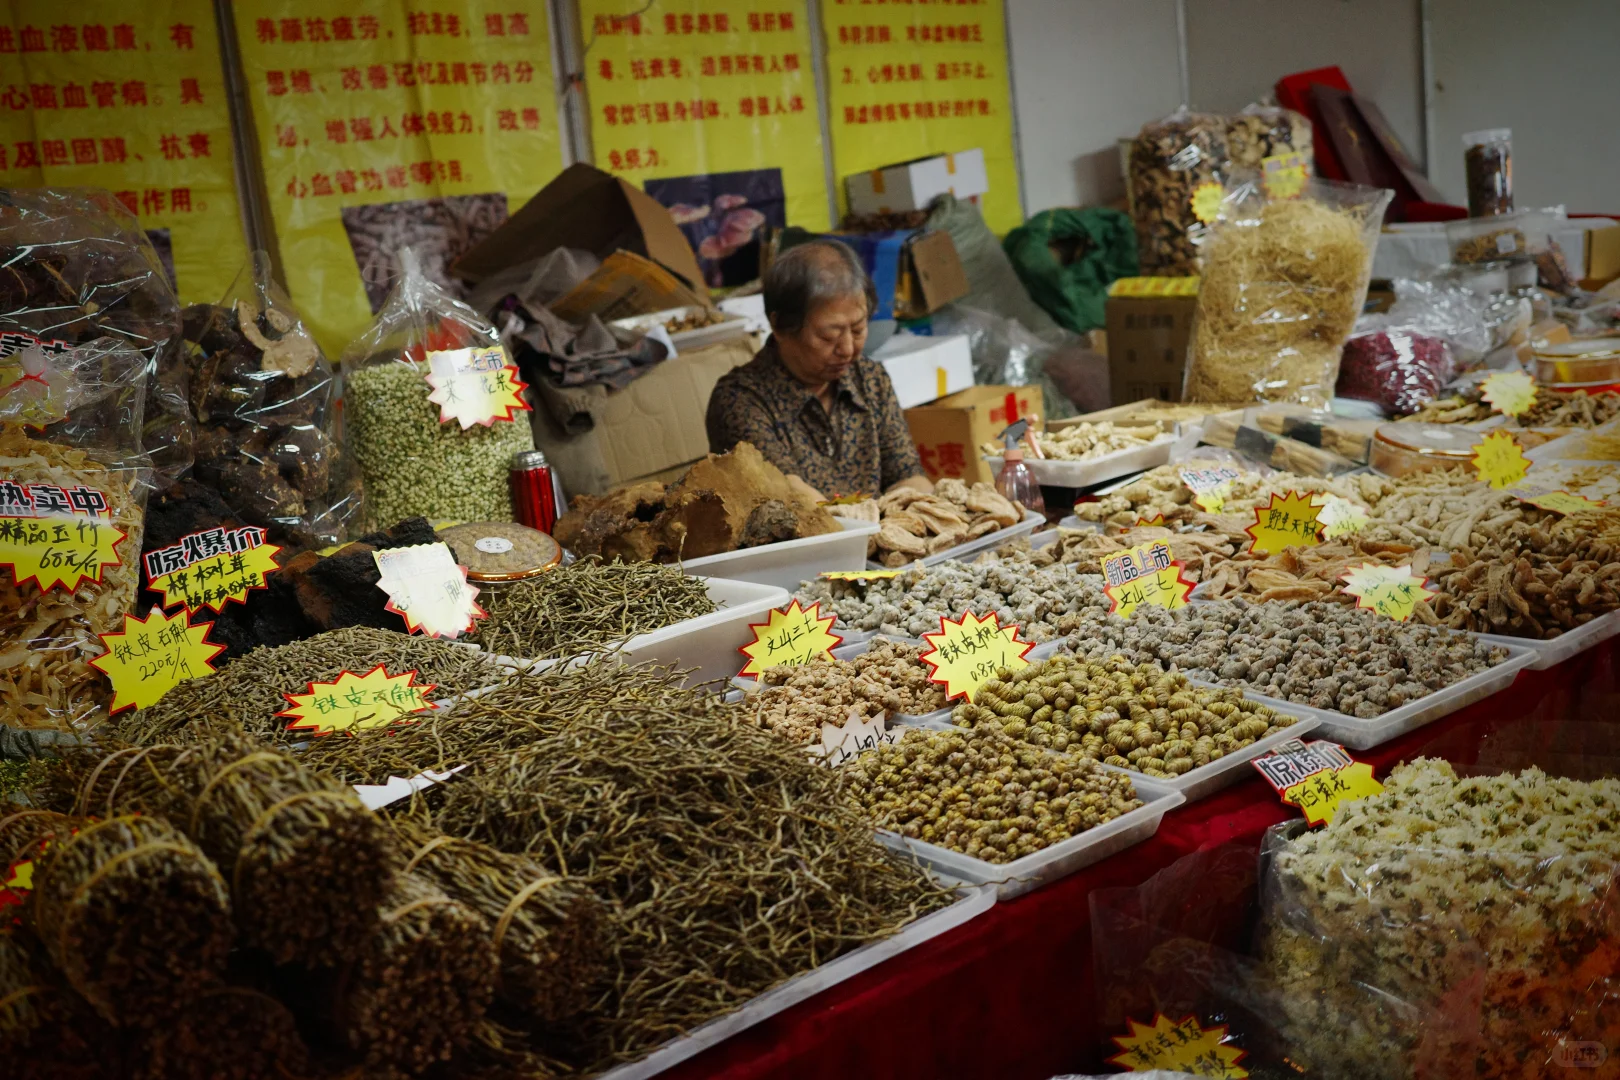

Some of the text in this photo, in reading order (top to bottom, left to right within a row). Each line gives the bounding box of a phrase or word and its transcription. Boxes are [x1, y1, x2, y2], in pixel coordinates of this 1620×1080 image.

[148, 528, 261, 577] 惊爆价
[1106, 545, 1170, 585] 新品上市
[1120, 573, 1173, 609] 文山三七
[114, 618, 191, 665] 铁皮石斛
[767, 614, 818, 656] 文山三七
[139, 647, 194, 681] 220元/斤
